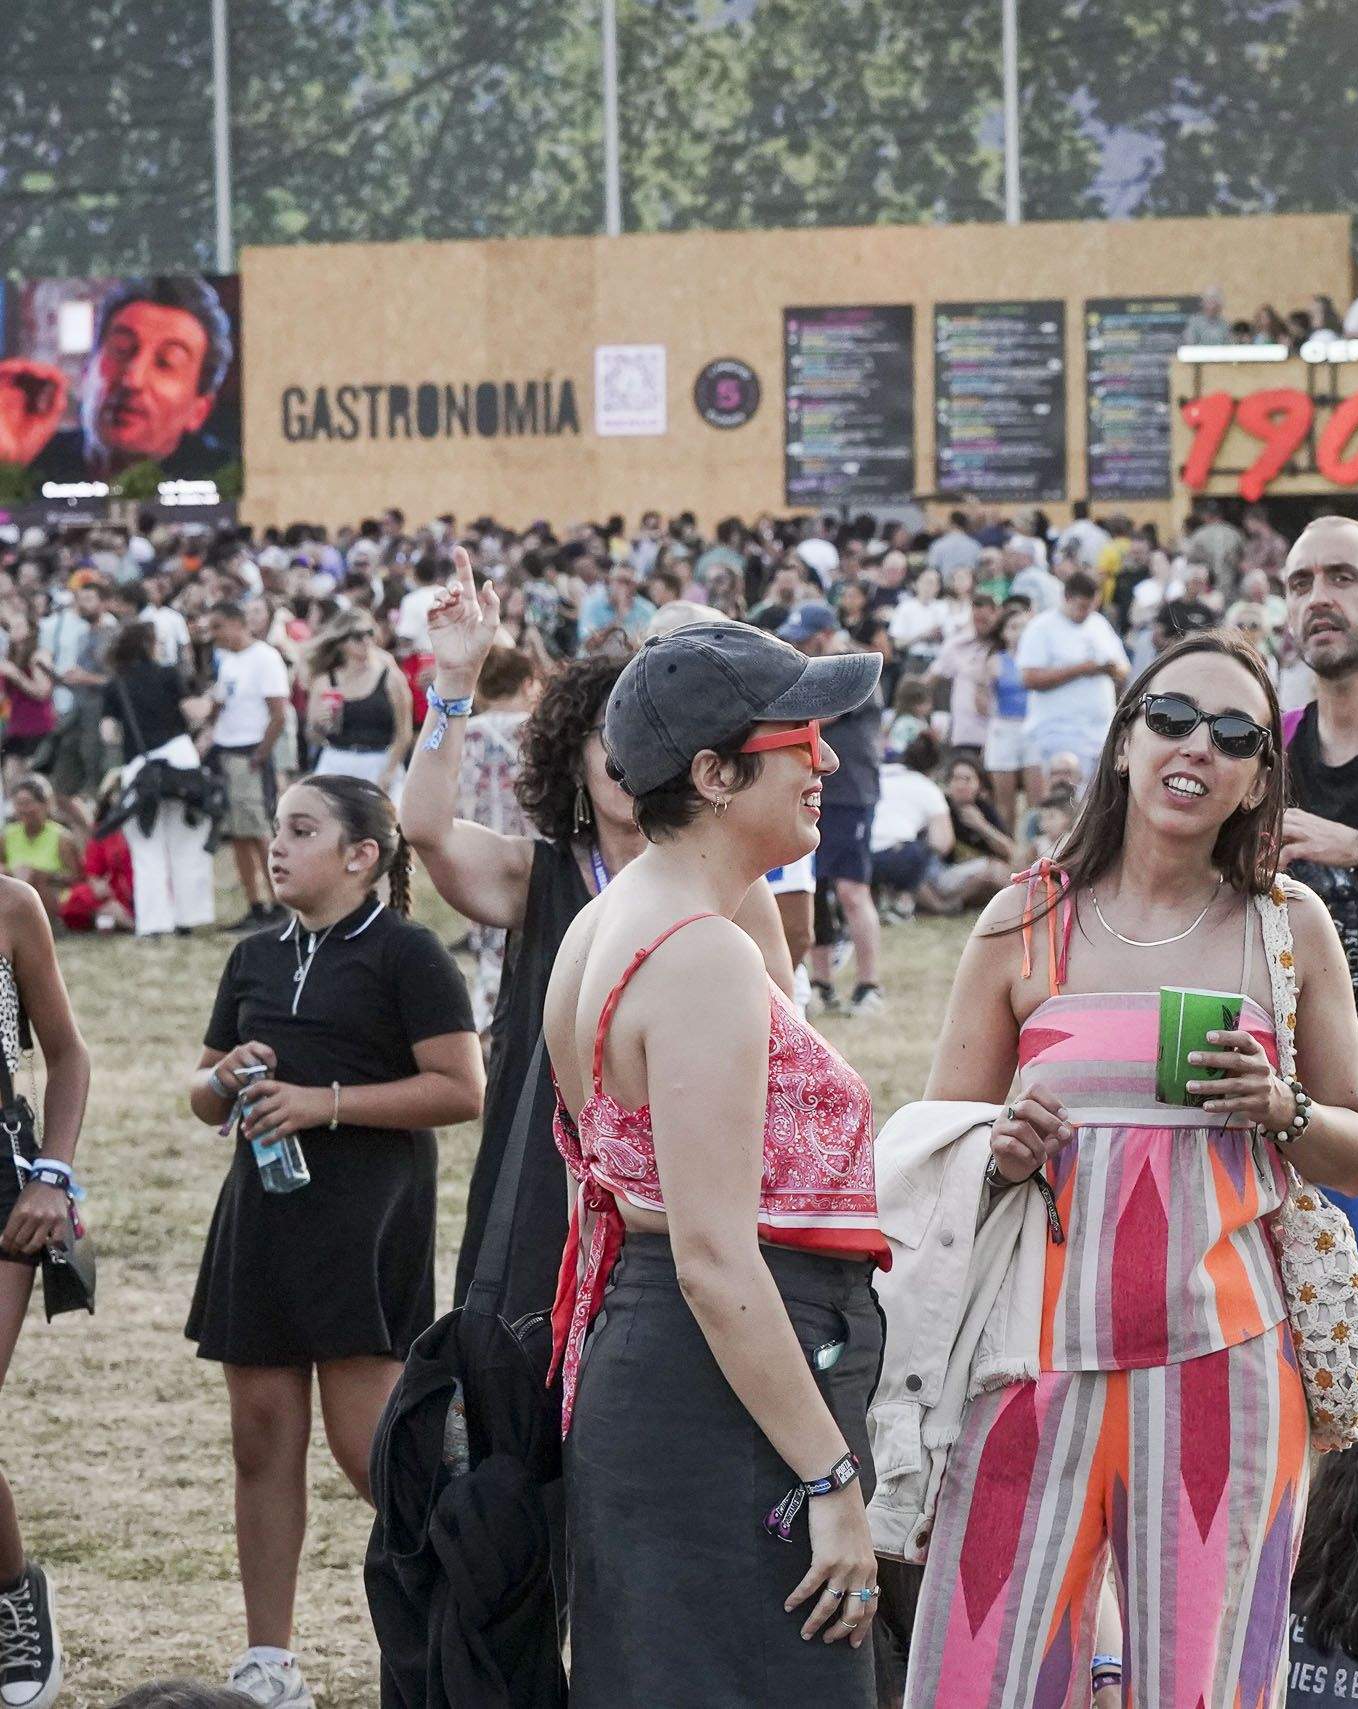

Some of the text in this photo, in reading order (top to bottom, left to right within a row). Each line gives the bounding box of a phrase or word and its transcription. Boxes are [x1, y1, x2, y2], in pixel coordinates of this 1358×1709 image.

[282, 371, 581, 442] GASTRONOMÍA
[1289, 1661, 1328, 1694] IES
[1334, 1668, 1348, 1698] &
